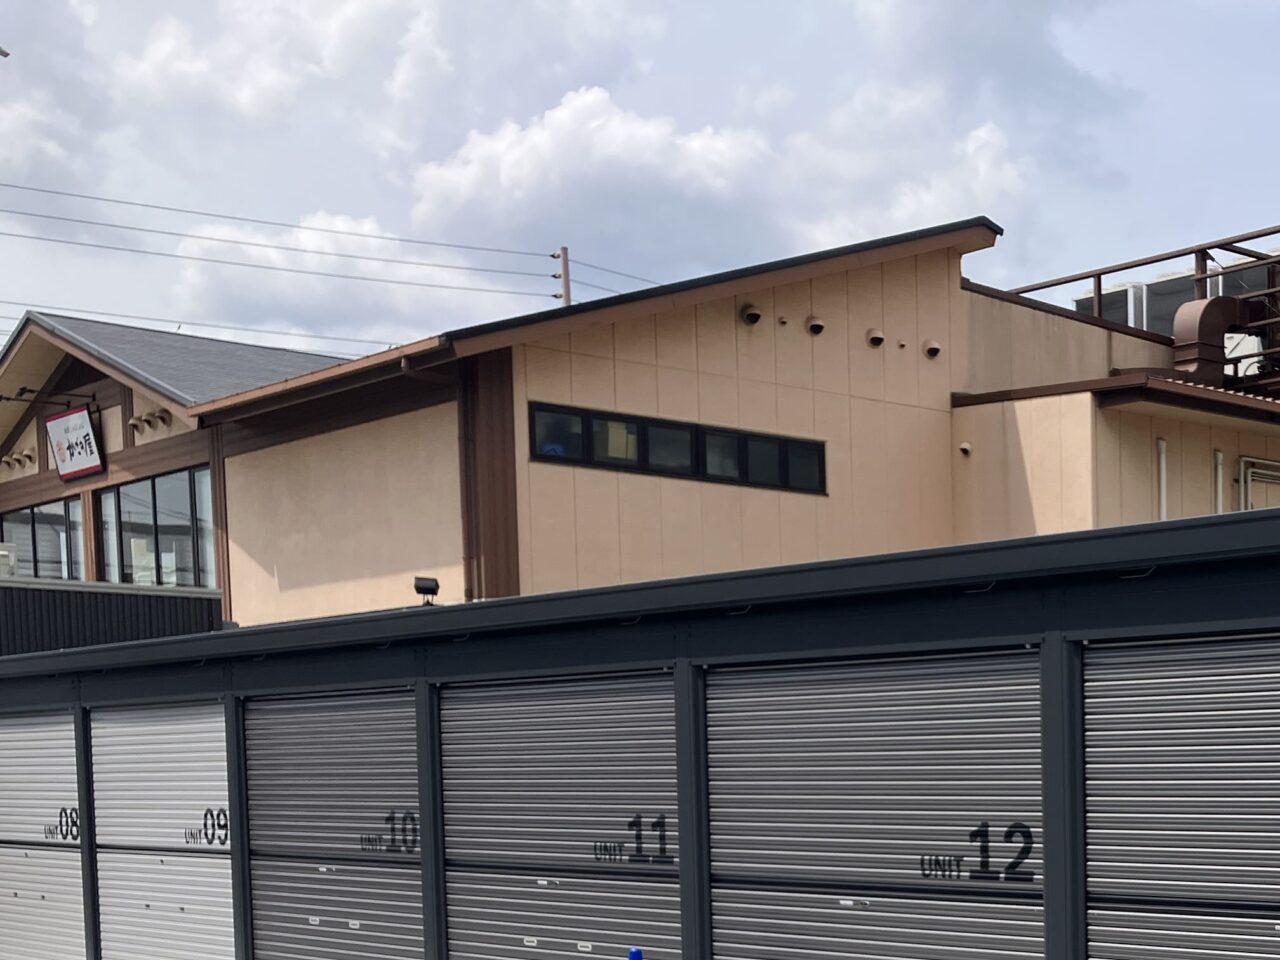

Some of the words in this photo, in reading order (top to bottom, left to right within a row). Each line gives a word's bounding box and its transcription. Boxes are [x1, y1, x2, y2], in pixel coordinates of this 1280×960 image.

[44, 824, 59, 840] UNIT
[59, 807, 80, 841] 08
[184, 828, 202, 845] UNIT
[203, 808, 229, 846] 09
[361, 834, 382, 851] UNIT
[385, 811, 417, 854] 10
[594, 842, 624, 862] UNIT
[628, 813, 674, 863] 11
[920, 855, 963, 879] UNIT
[968, 821, 1036, 882] 12
